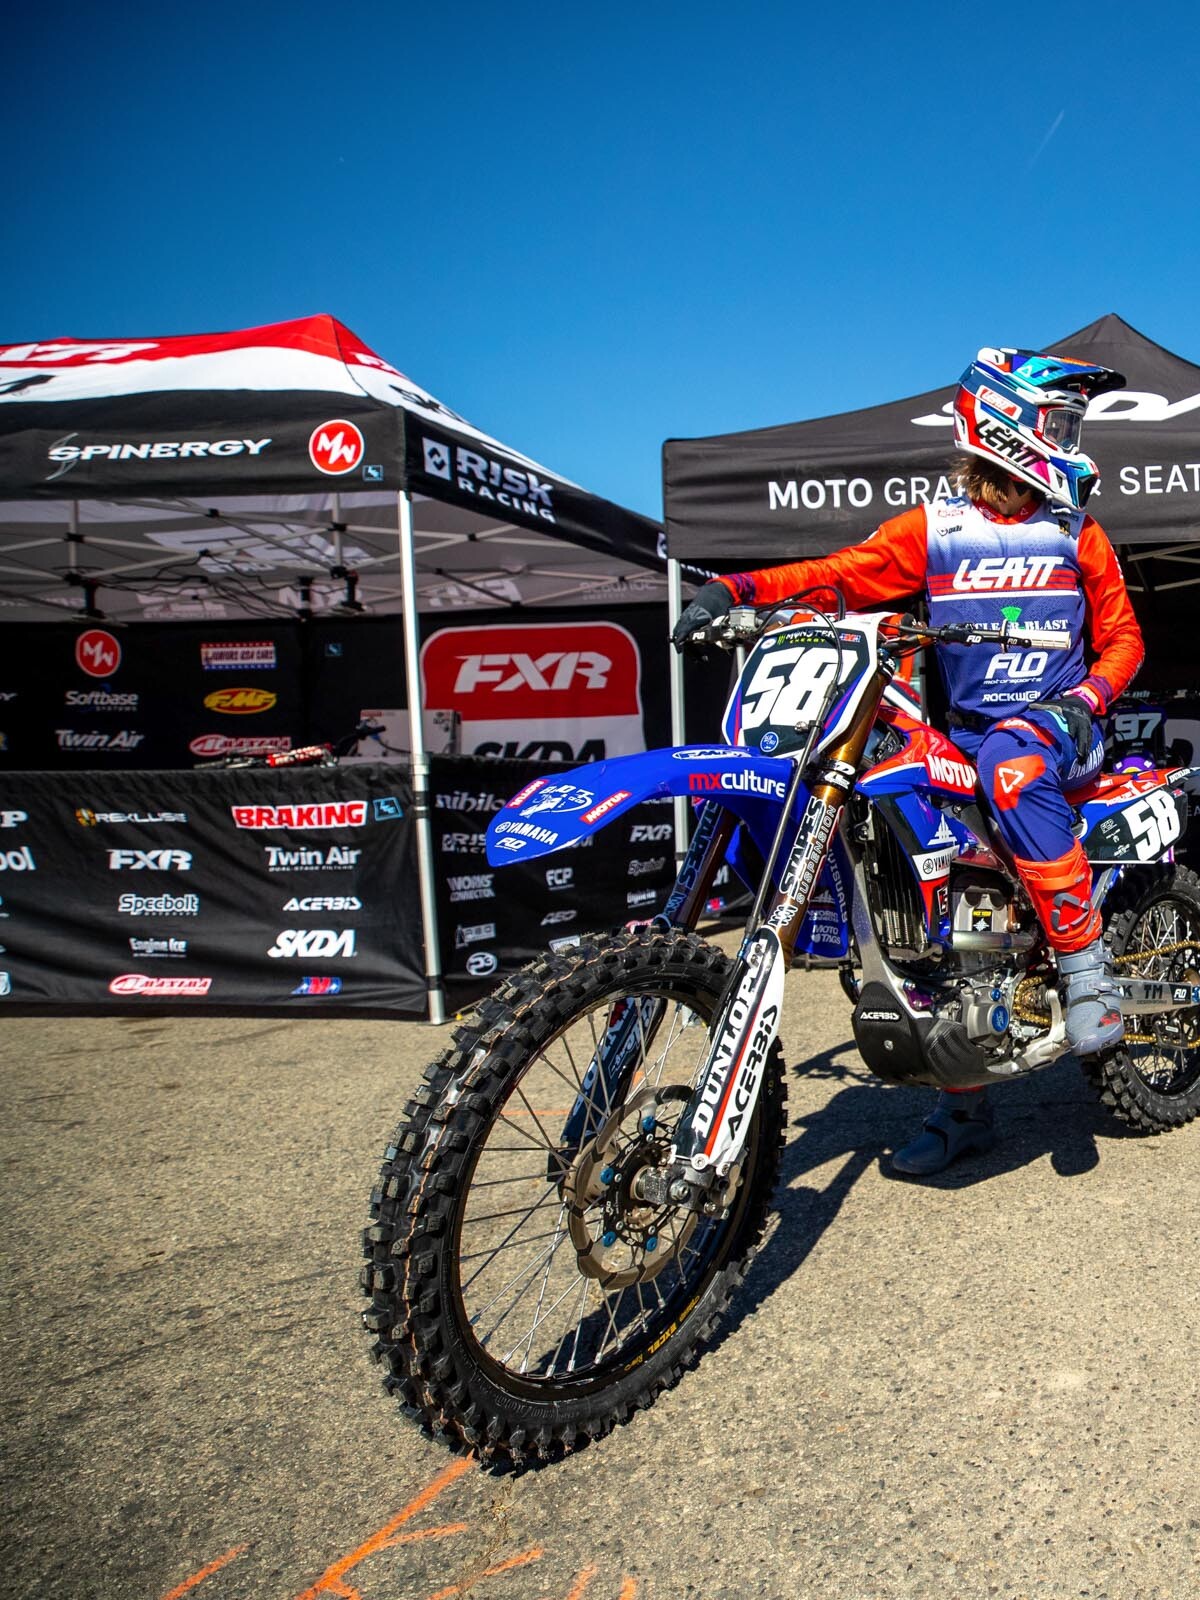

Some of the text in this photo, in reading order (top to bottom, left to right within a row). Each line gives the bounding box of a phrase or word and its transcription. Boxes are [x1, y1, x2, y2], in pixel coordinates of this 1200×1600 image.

[48, 438, 272, 461] SPINERGY
[974, 417, 1050, 469] LEATT
[457, 476, 556, 524] RACING
[767, 477, 872, 511] MOTO
[952, 556, 1064, 590] LEATT
[967, 635, 982, 643] FLO
[454, 651, 613, 694] FXR
[985, 651, 1048, 679] FLO
[65, 690, 139, 706] Softbase
[741, 647, 859, 730] 58
[55, 729, 144, 747] Twin Air
[1115, 712, 1162, 742] 97
[688, 769, 786, 798] mxculture
[926, 753, 977, 789] MOTU
[509, 780, 545, 807] MOTUL
[585, 791, 629, 823] MOTUL
[232, 802, 367, 829] BRAKING
[1121, 789, 1181, 862] 58
[452, 832, 486, 847] RIS
[507, 822, 559, 846] YAMAHA
[630, 824, 673, 843] FXR
[106, 849, 193, 871] FXR
[264, 847, 362, 867] Twin Air
[795, 804, 837, 905] SUSPENSION
[545, 867, 573, 886] FCP
[118, 893, 200, 916] Specbolt
[283, 897, 362, 912] ACERBIS
[813, 924, 839, 935] MOTO
[129, 937, 187, 953] Engine Ice
[267, 929, 355, 958] SKDA
[1144, 984, 1163, 999] TM
[860, 1011, 899, 1020] ACERBIS
[692, 972, 758, 1138] DUNLOP
[728, 1004, 778, 1140] ACERBIS
